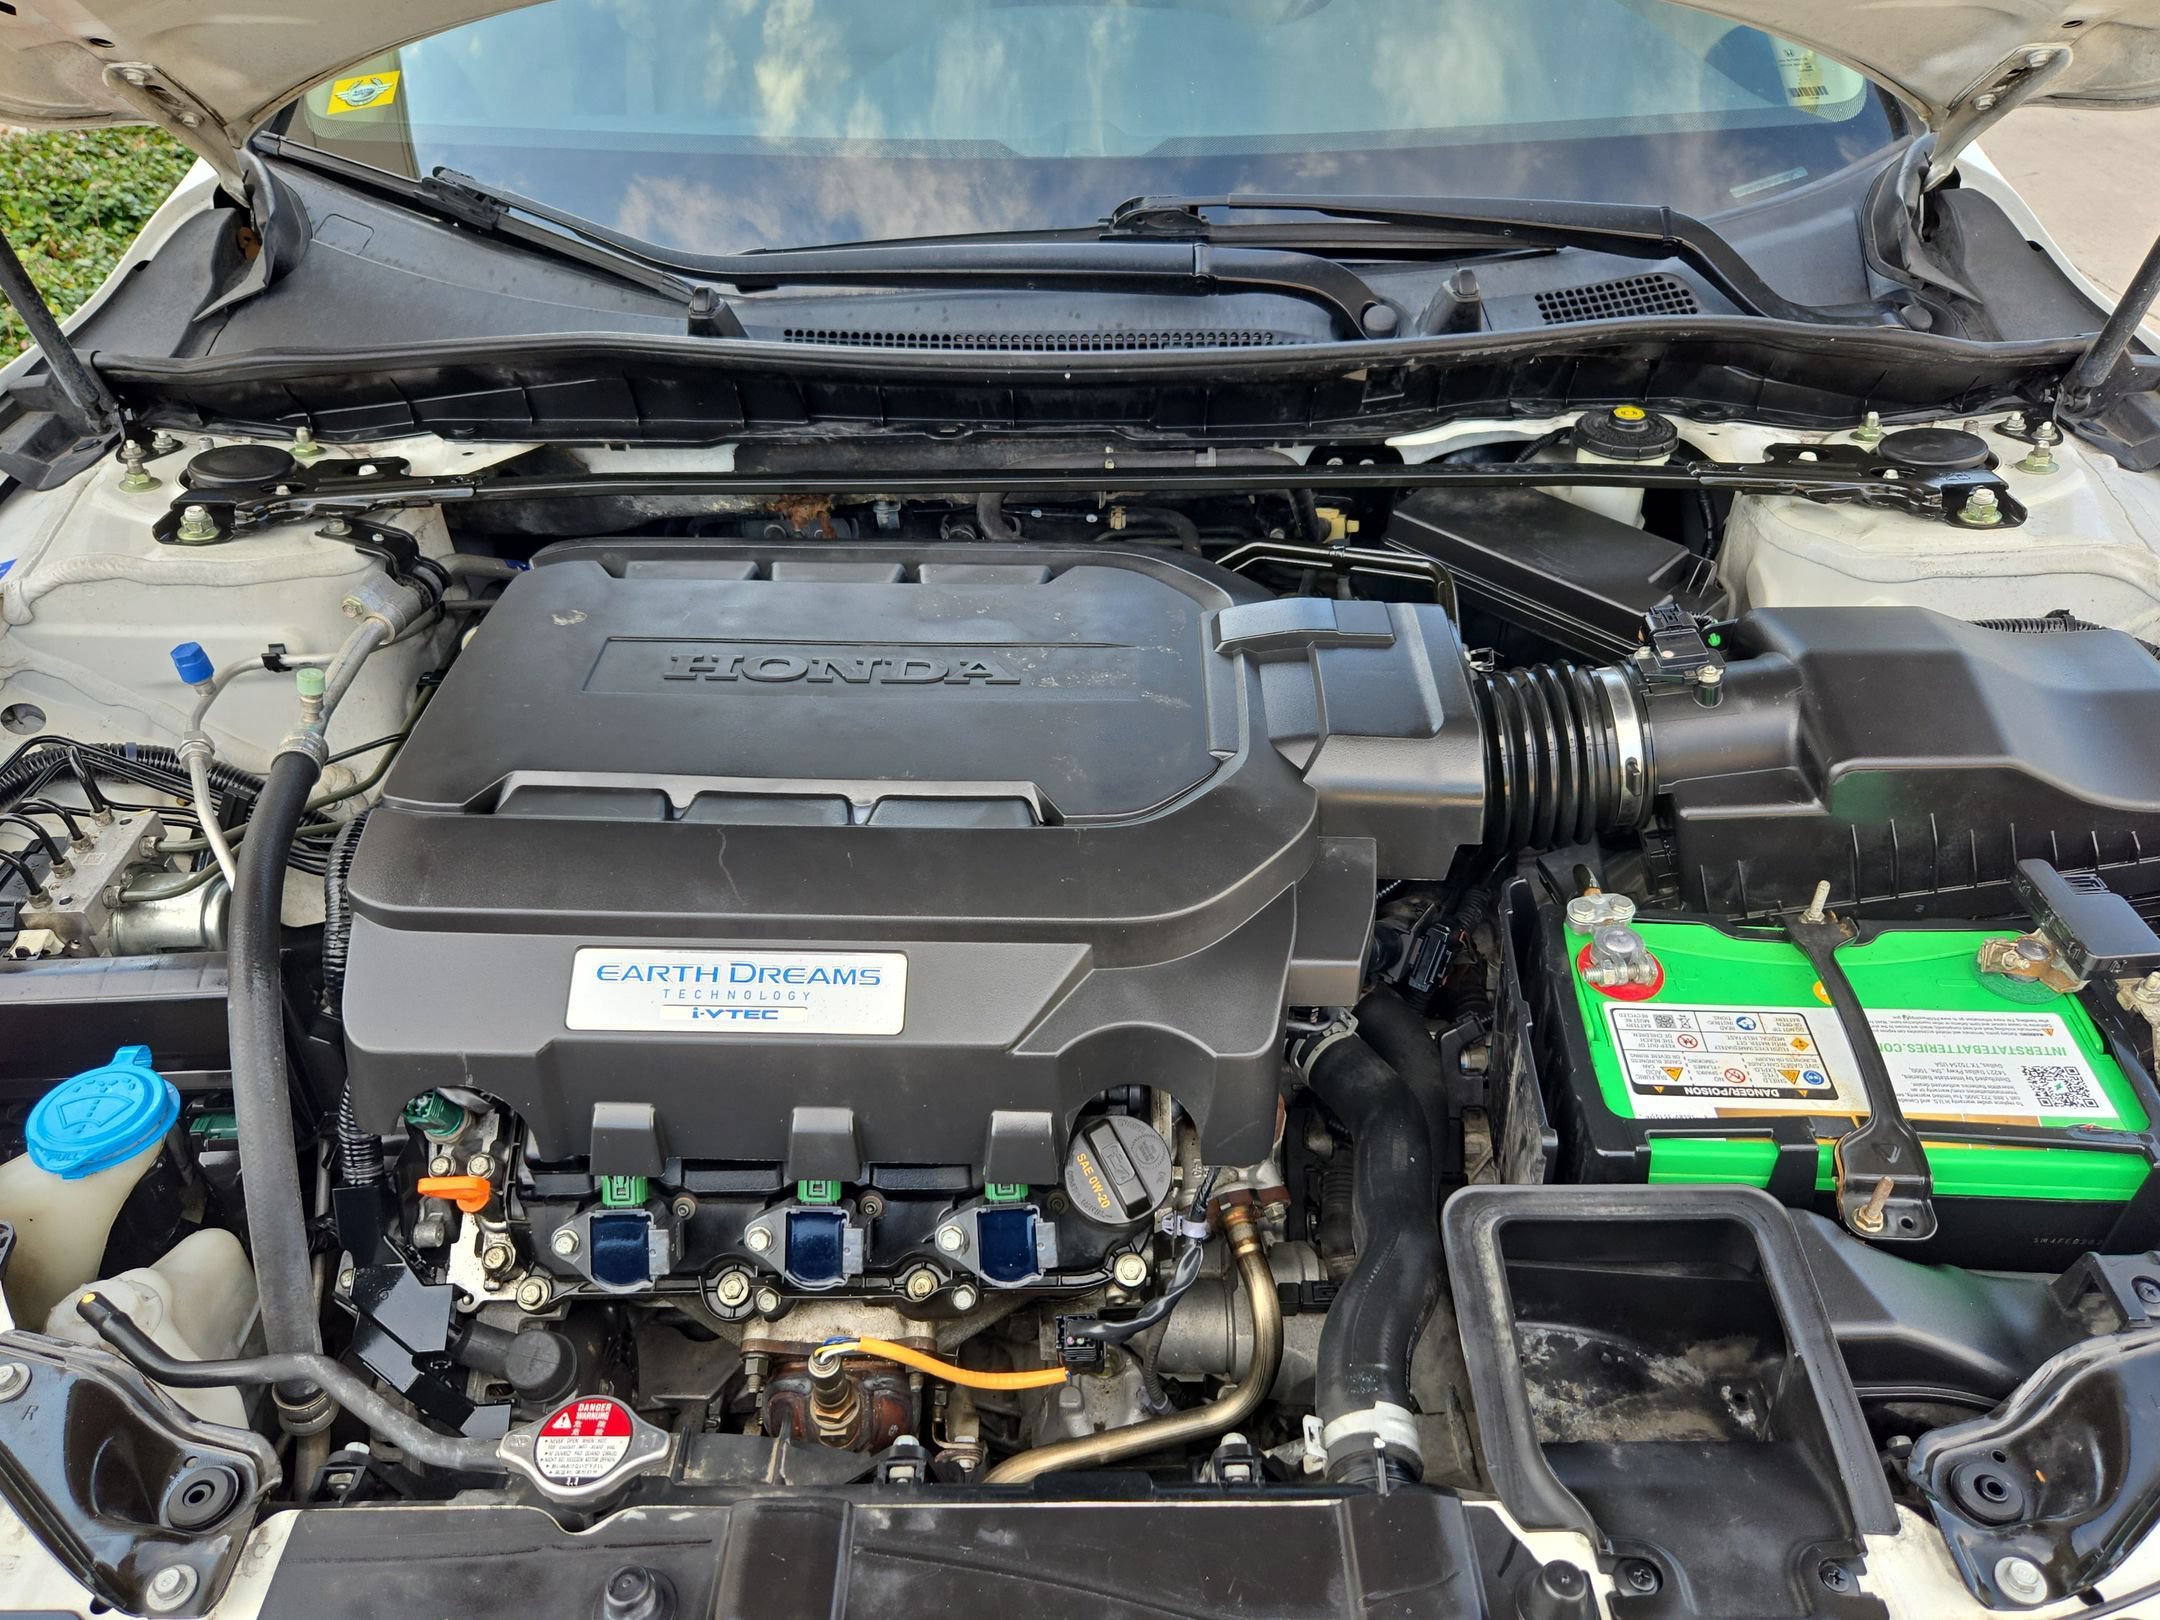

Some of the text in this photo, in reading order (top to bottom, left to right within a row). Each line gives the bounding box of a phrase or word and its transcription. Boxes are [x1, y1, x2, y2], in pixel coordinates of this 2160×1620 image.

[664, 655, 1021, 685] HONDA
[597, 962, 882, 986] EARTH DREAMS
[664, 989, 811, 1002] TECHNOLOGY
[692, 1007, 779, 1020] i-VTEC
[1684, 1087, 1780, 1098] DANGER/POISON
[1077, 1153, 1094, 1177] SAE
[1088, 1176, 1111, 1208] 0W-20
[578, 1403, 613, 1412] DANGER
